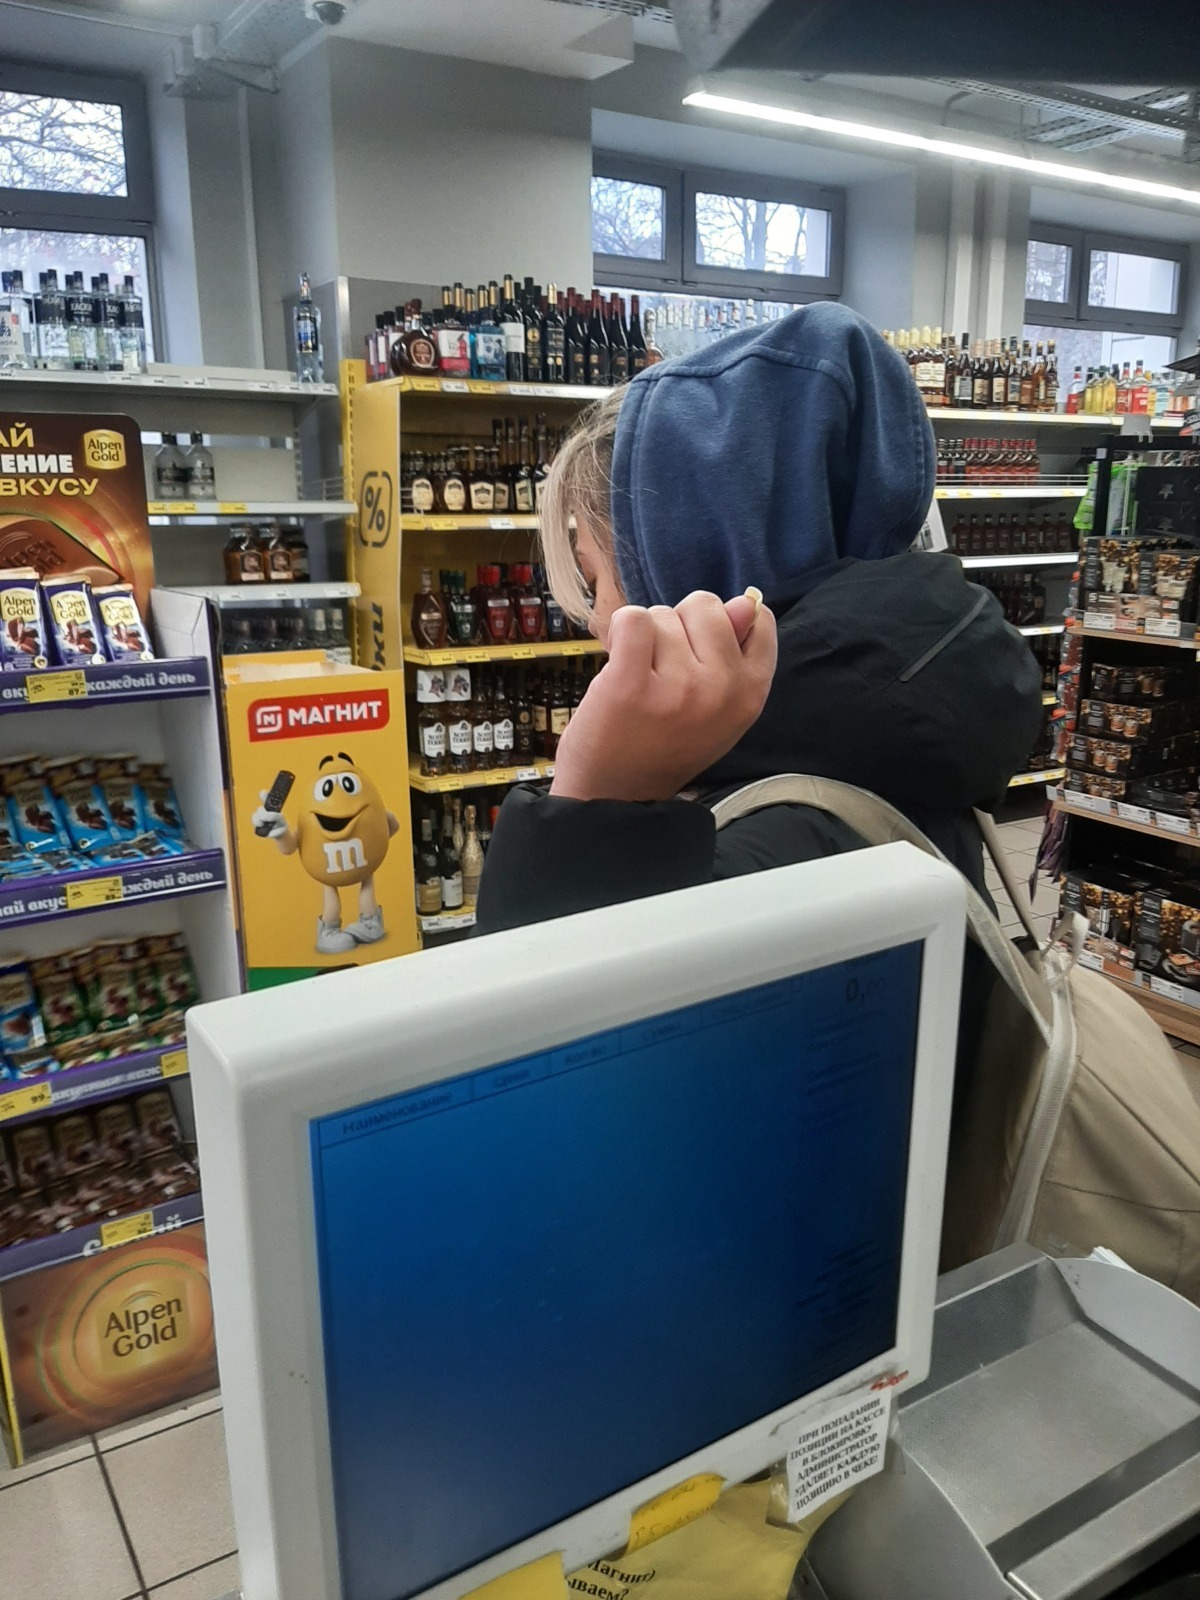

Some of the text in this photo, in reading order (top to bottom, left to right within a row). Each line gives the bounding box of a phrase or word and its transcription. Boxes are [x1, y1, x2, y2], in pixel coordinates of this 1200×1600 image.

[88, 438, 122, 452] Alpen
[91, 450, 120, 462] Gold
[0, 478, 99, 496] ВКУСУ
[4, 596, 36, 606] Alpen
[7, 606, 34, 616] Gold
[56, 600, 86, 609] Apen
[60, 608, 86, 618] Gold
[86, 674, 156, 691] каждый
[159, 672, 196, 686] день
[288, 700, 382, 726] МАГНИТ
[323, 837, 368, 874] m
[28, 895, 66, 912] вкус
[123, 874, 175, 894] ждый
[177, 870, 214, 885] день
[342, 1092, 452, 1134] Наименование
[104, 1297, 182, 1338] Alpen
[112, 1316, 178, 1358] Gold
[790, 1406, 886, 1460] ПОЗИЦИИ НА КАССЕ
[798, 1398, 880, 1444] ПРИ ПОПАДАНИИ
[797, 1432, 878, 1482] АДМИНИСТРАТОР
[802, 1424, 874, 1466] В БЛОКИРОВКУ
[795, 1443, 880, 1497] УДАЛЯЕТ КАЖДУЮ
[796, 1474, 842, 1510] ПОЗИЦИЮ
[844, 1468, 850, 1480] В
